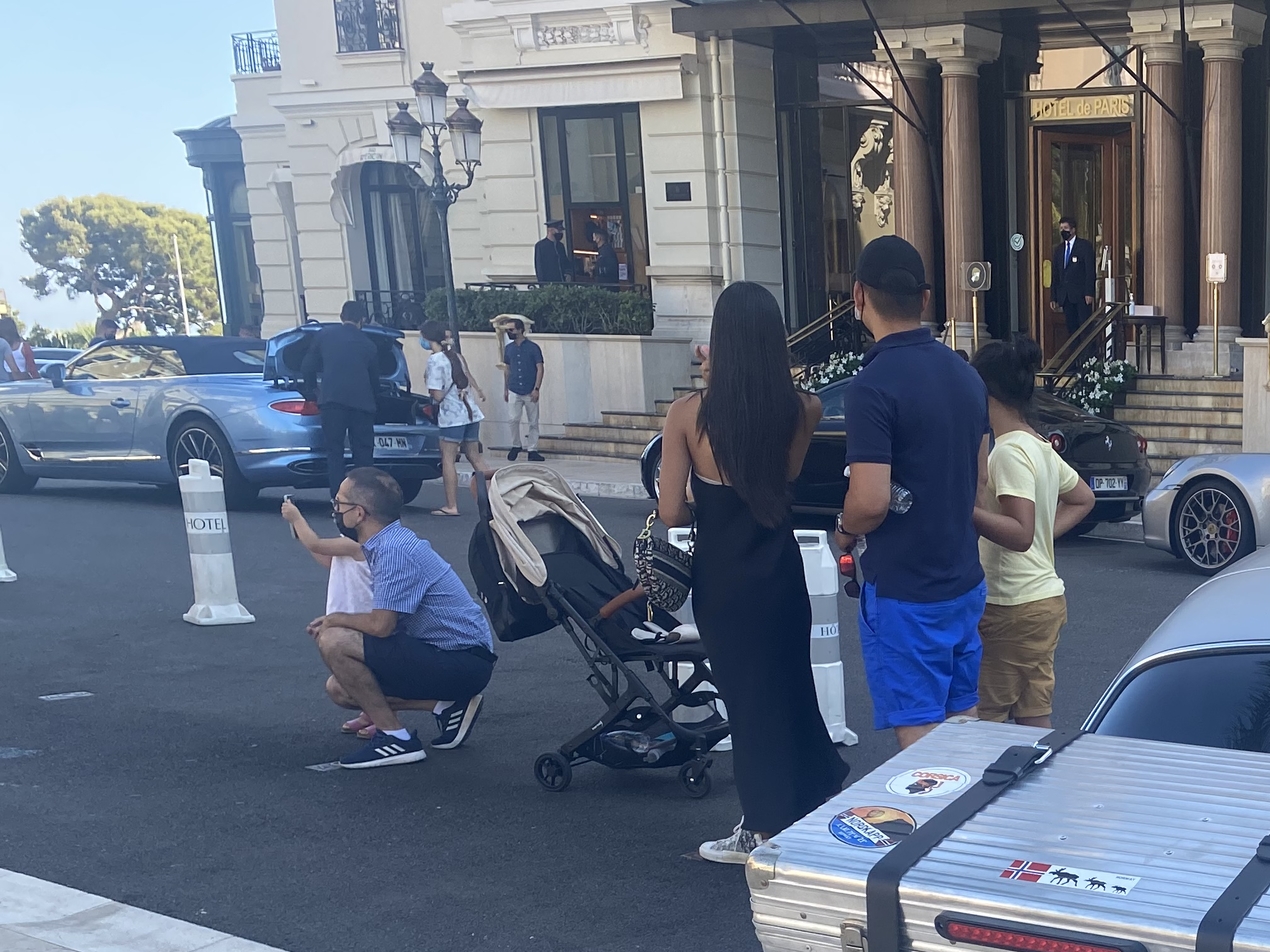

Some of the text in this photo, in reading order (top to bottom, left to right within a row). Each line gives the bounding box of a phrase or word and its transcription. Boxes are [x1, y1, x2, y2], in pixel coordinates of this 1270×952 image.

[1077, 102, 1091, 115] de
[1094, 98, 1130, 115] PARIS
[911, 771, 960, 781] CORSICA
[848, 816, 886, 841] NORDKAPP
